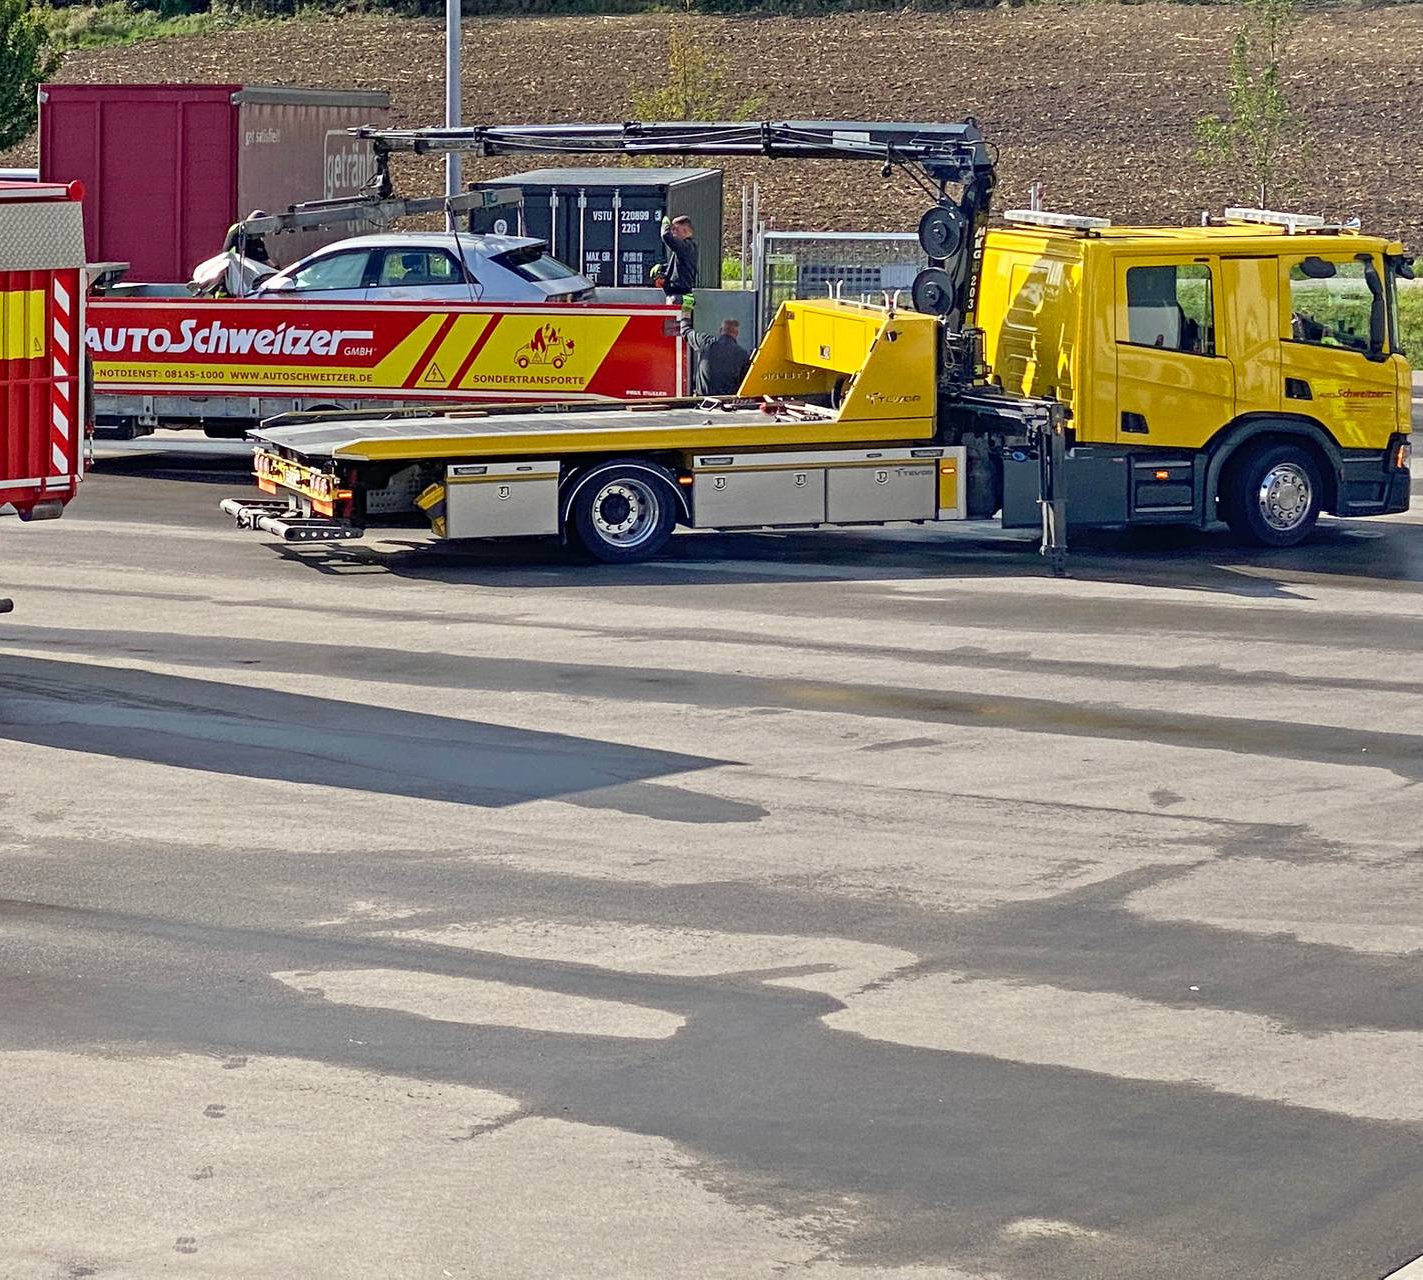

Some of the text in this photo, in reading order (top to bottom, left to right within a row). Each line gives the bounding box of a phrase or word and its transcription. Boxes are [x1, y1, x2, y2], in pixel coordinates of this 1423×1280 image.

[327, 138, 377, 199] getränk
[592, 210, 613, 221] VSTU
[343, 346, 373, 356] GMBH
[92, 369, 373, 383] -NOTDIENST: 08145-1000 WWW.AUTOSCHWEITZER.DE
[472, 374, 585, 386] SONDERTRANSPORTE
